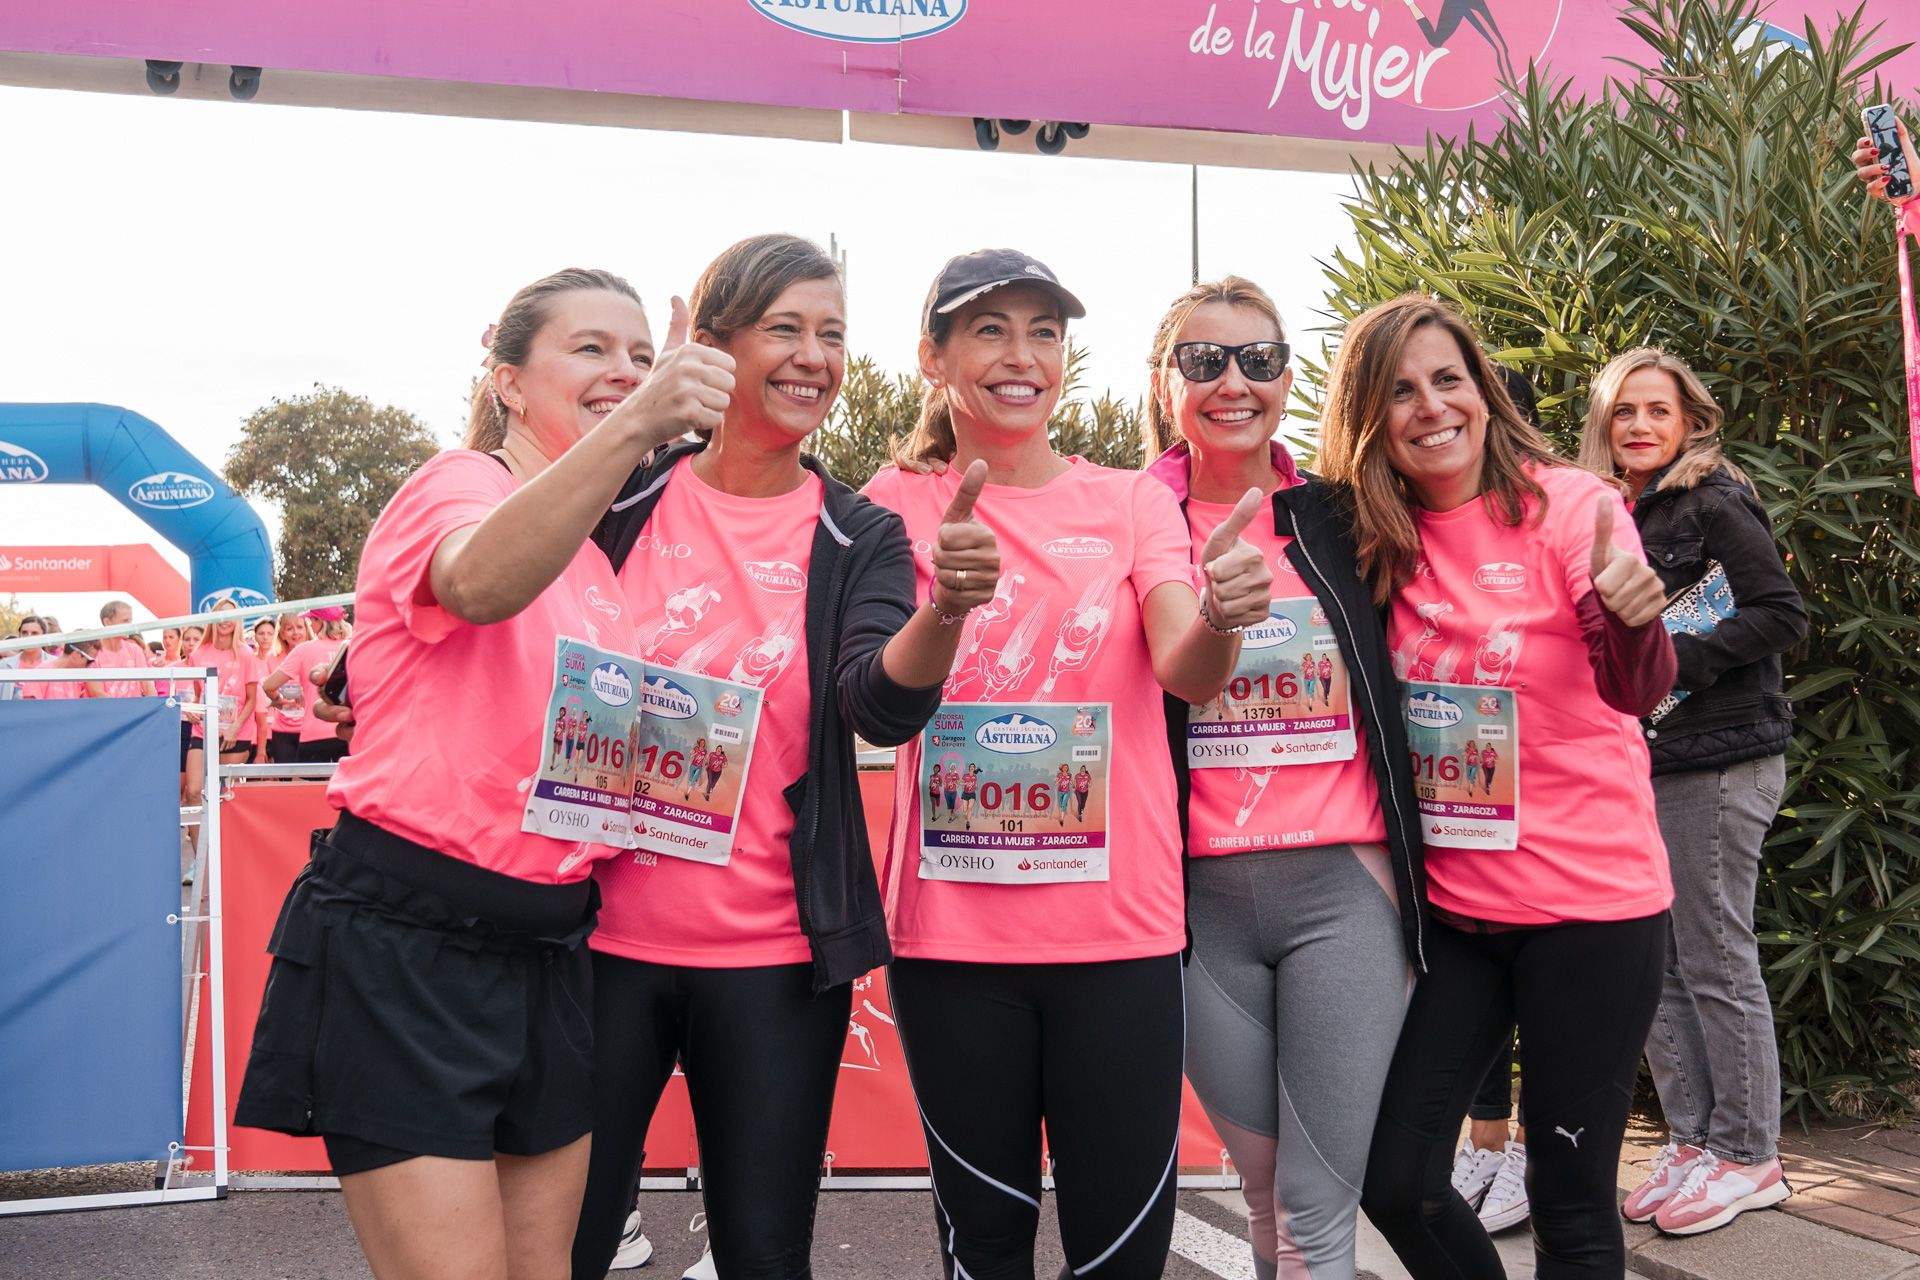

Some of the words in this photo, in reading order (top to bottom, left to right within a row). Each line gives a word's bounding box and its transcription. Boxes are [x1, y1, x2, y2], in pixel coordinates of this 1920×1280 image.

[1189, 3, 1234, 55] de
[1244, 5, 1275, 60] la
[1267, 8, 1450, 131] Mujer
[136, 486, 208, 501] ASTURIANA
[15, 556, 92, 570] Santander
[1242, 626, 1292, 640] TURIANA
[565, 658, 585, 671] SUMA
[593, 676, 630, 699] ASTURIANA
[1229, 672, 1298, 701] 016
[642, 692, 691, 715] TURIANA
[1243, 707, 1282, 720] 13791
[934, 721, 964, 730] SUMA
[1075, 715, 1092, 728] 20
[1192, 723, 1229, 734] CARRERA
[1231, 724, 1242, 733] DE
[1244, 723, 1255, 732] LA
[1257, 722, 1286, 732] MUJER
[1293, 718, 1336, 730] ZARAGOZA
[980, 728, 1051, 744] ASTURIANA
[586, 733, 625, 769] 016
[1192, 744, 1249, 757] OYSHO
[1286, 740, 1338, 754] Santander
[638, 745, 685, 779] 16
[979, 782, 1051, 811] 016
[1420, 786, 1436, 799] 103
[663, 806, 712, 826] ZARAGOZA
[1424, 803, 1446, 813] MUJER
[1453, 805, 1498, 816] ZARAGOZA
[549, 808, 590, 829] OYSHO
[1000, 820, 1023, 832] 101
[649, 827, 708, 850] Santander
[1443, 825, 1498, 838] Santander
[940, 834, 976, 844] CARRERA
[978, 835, 989, 845] DE
[991, 836, 1003, 846] LA
[1005, 836, 1035, 846] MUJER
[1042, 836, 1088, 845] ZARAGOZA
[1208, 834, 1250, 849] CARRERA
[1253, 835, 1265, 845] DE
[1268, 833, 1280, 844] LA
[1281, 830, 1315, 844] MUJER
[634, 852, 658, 867] 2024
[940, 854, 994, 870] OYSHO
[1033, 859, 1088, 870] Santander
